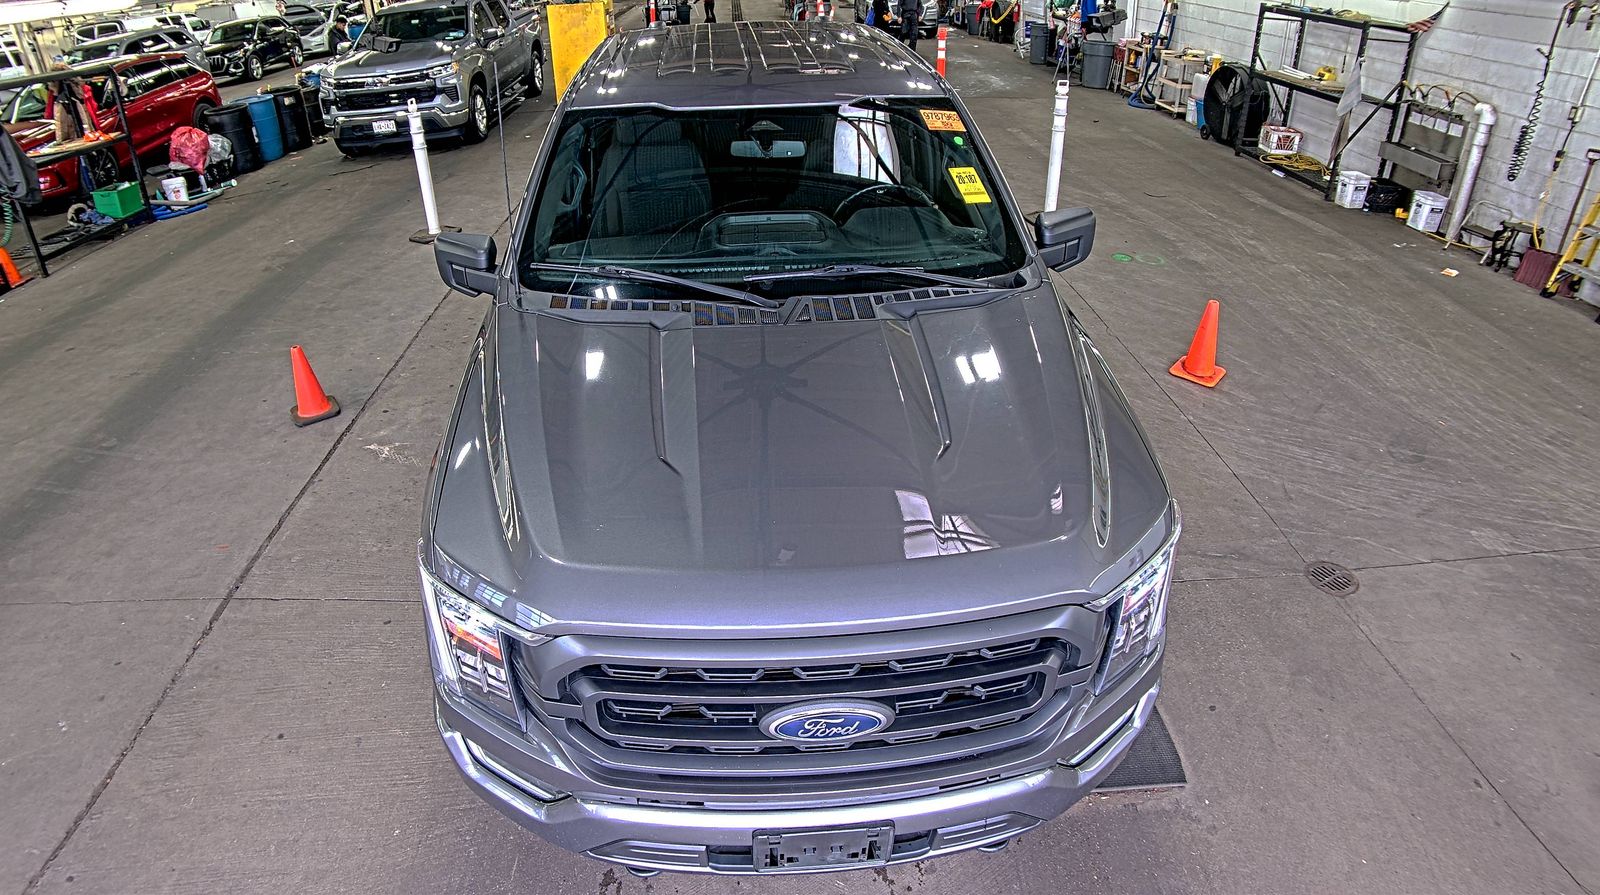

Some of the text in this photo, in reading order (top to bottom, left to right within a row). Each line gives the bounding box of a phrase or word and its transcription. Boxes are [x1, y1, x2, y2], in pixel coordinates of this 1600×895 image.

[923, 111, 961, 122] 9787963
[956, 174, 978, 185] 20:187
[797, 717, 861, 738] Ford
